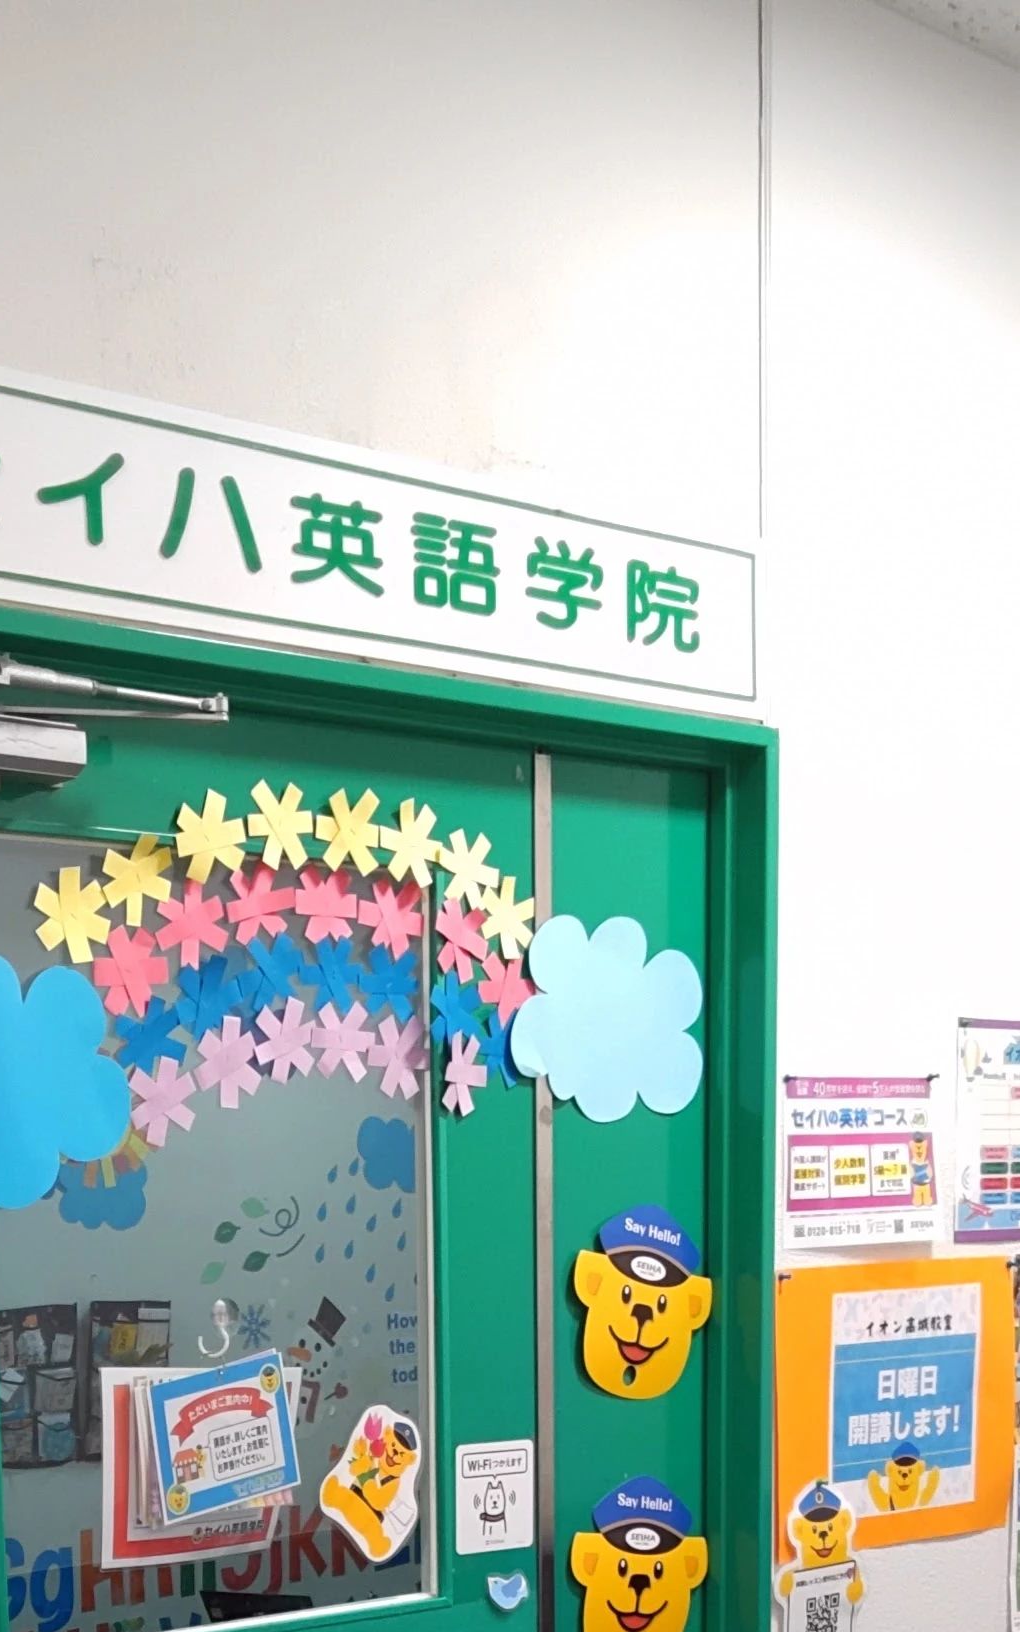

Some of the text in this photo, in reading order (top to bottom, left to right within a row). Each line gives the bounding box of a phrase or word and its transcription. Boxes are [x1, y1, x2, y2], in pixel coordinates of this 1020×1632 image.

[834, 1158, 866, 1169] 少人数制
[625, 1217, 681, 1246] Say Hello!
[636, 1260, 663, 1274] SEIHA
[877, 1366, 938, 1401] 日曜日
[617, 1492, 673, 1512] Say Hello!
